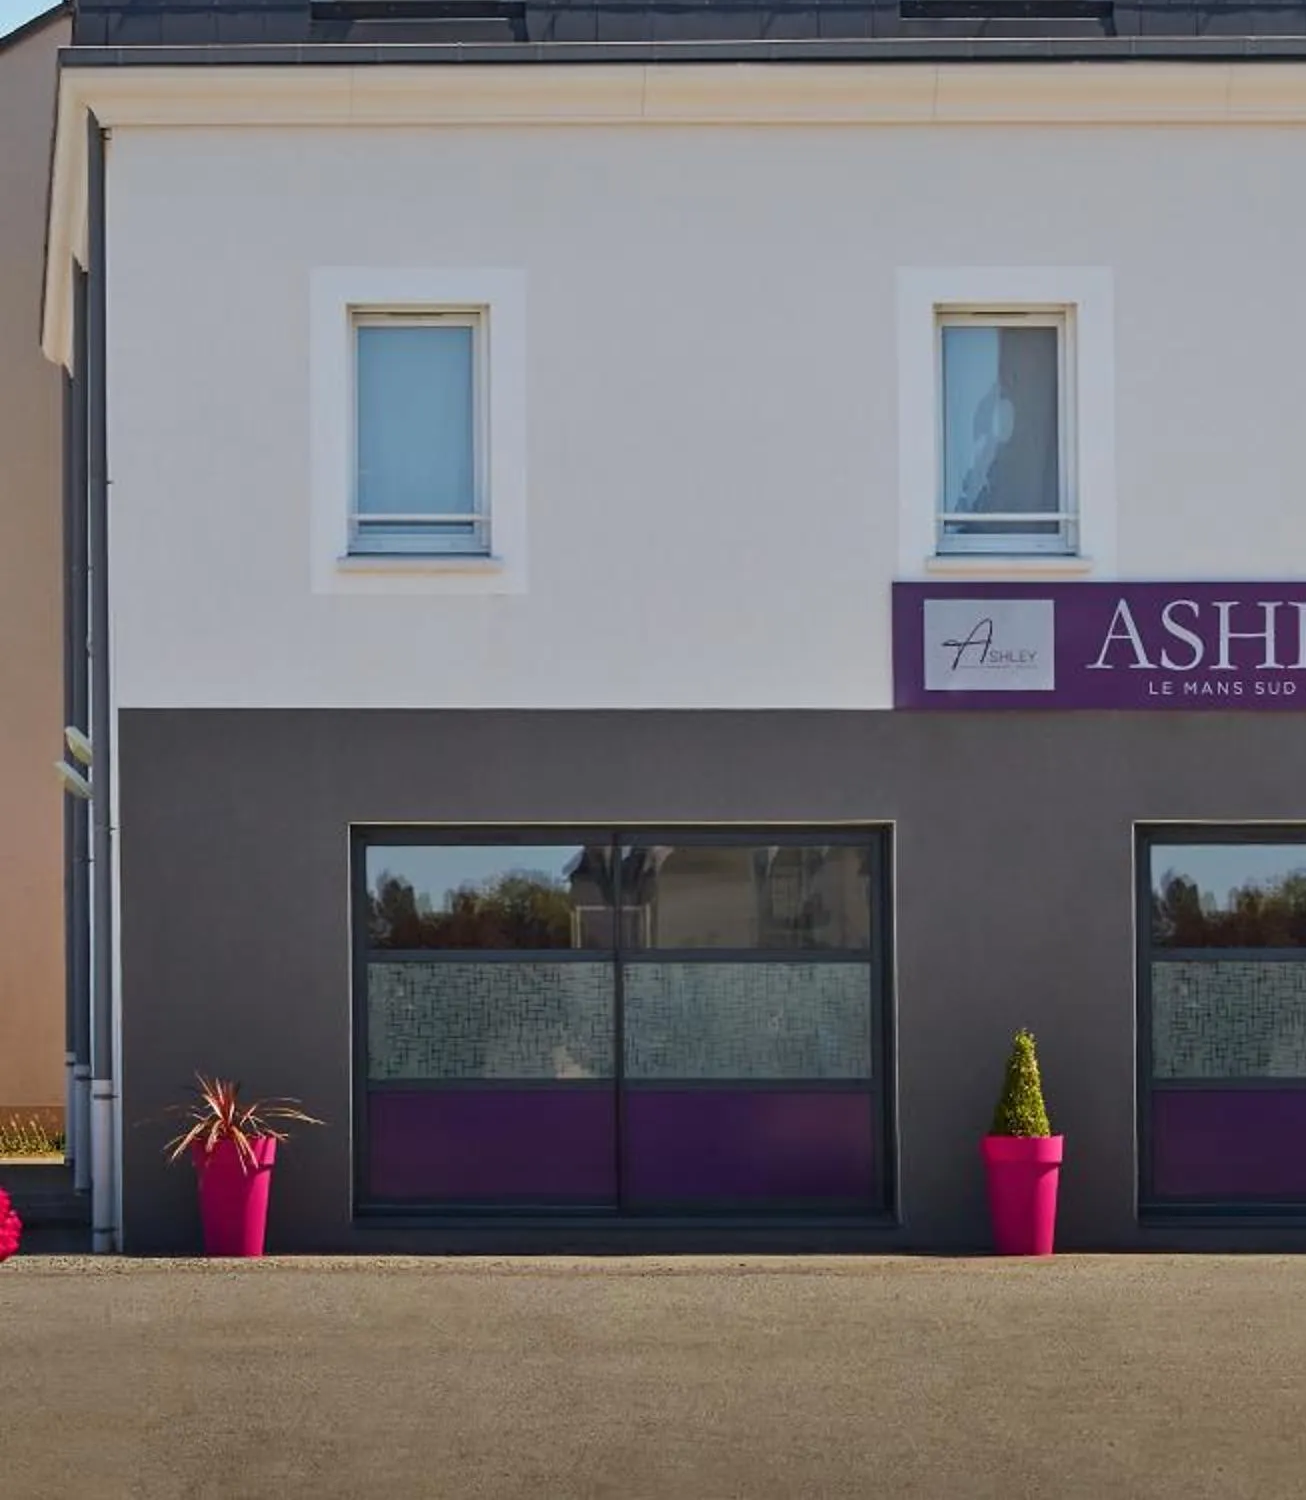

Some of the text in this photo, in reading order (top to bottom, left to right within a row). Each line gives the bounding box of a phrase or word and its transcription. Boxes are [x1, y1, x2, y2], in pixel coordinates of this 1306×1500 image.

[1149, 680, 1172, 696] LE
[1184, 680, 1243, 696] MANS
[1255, 680, 1298, 696] SUD
